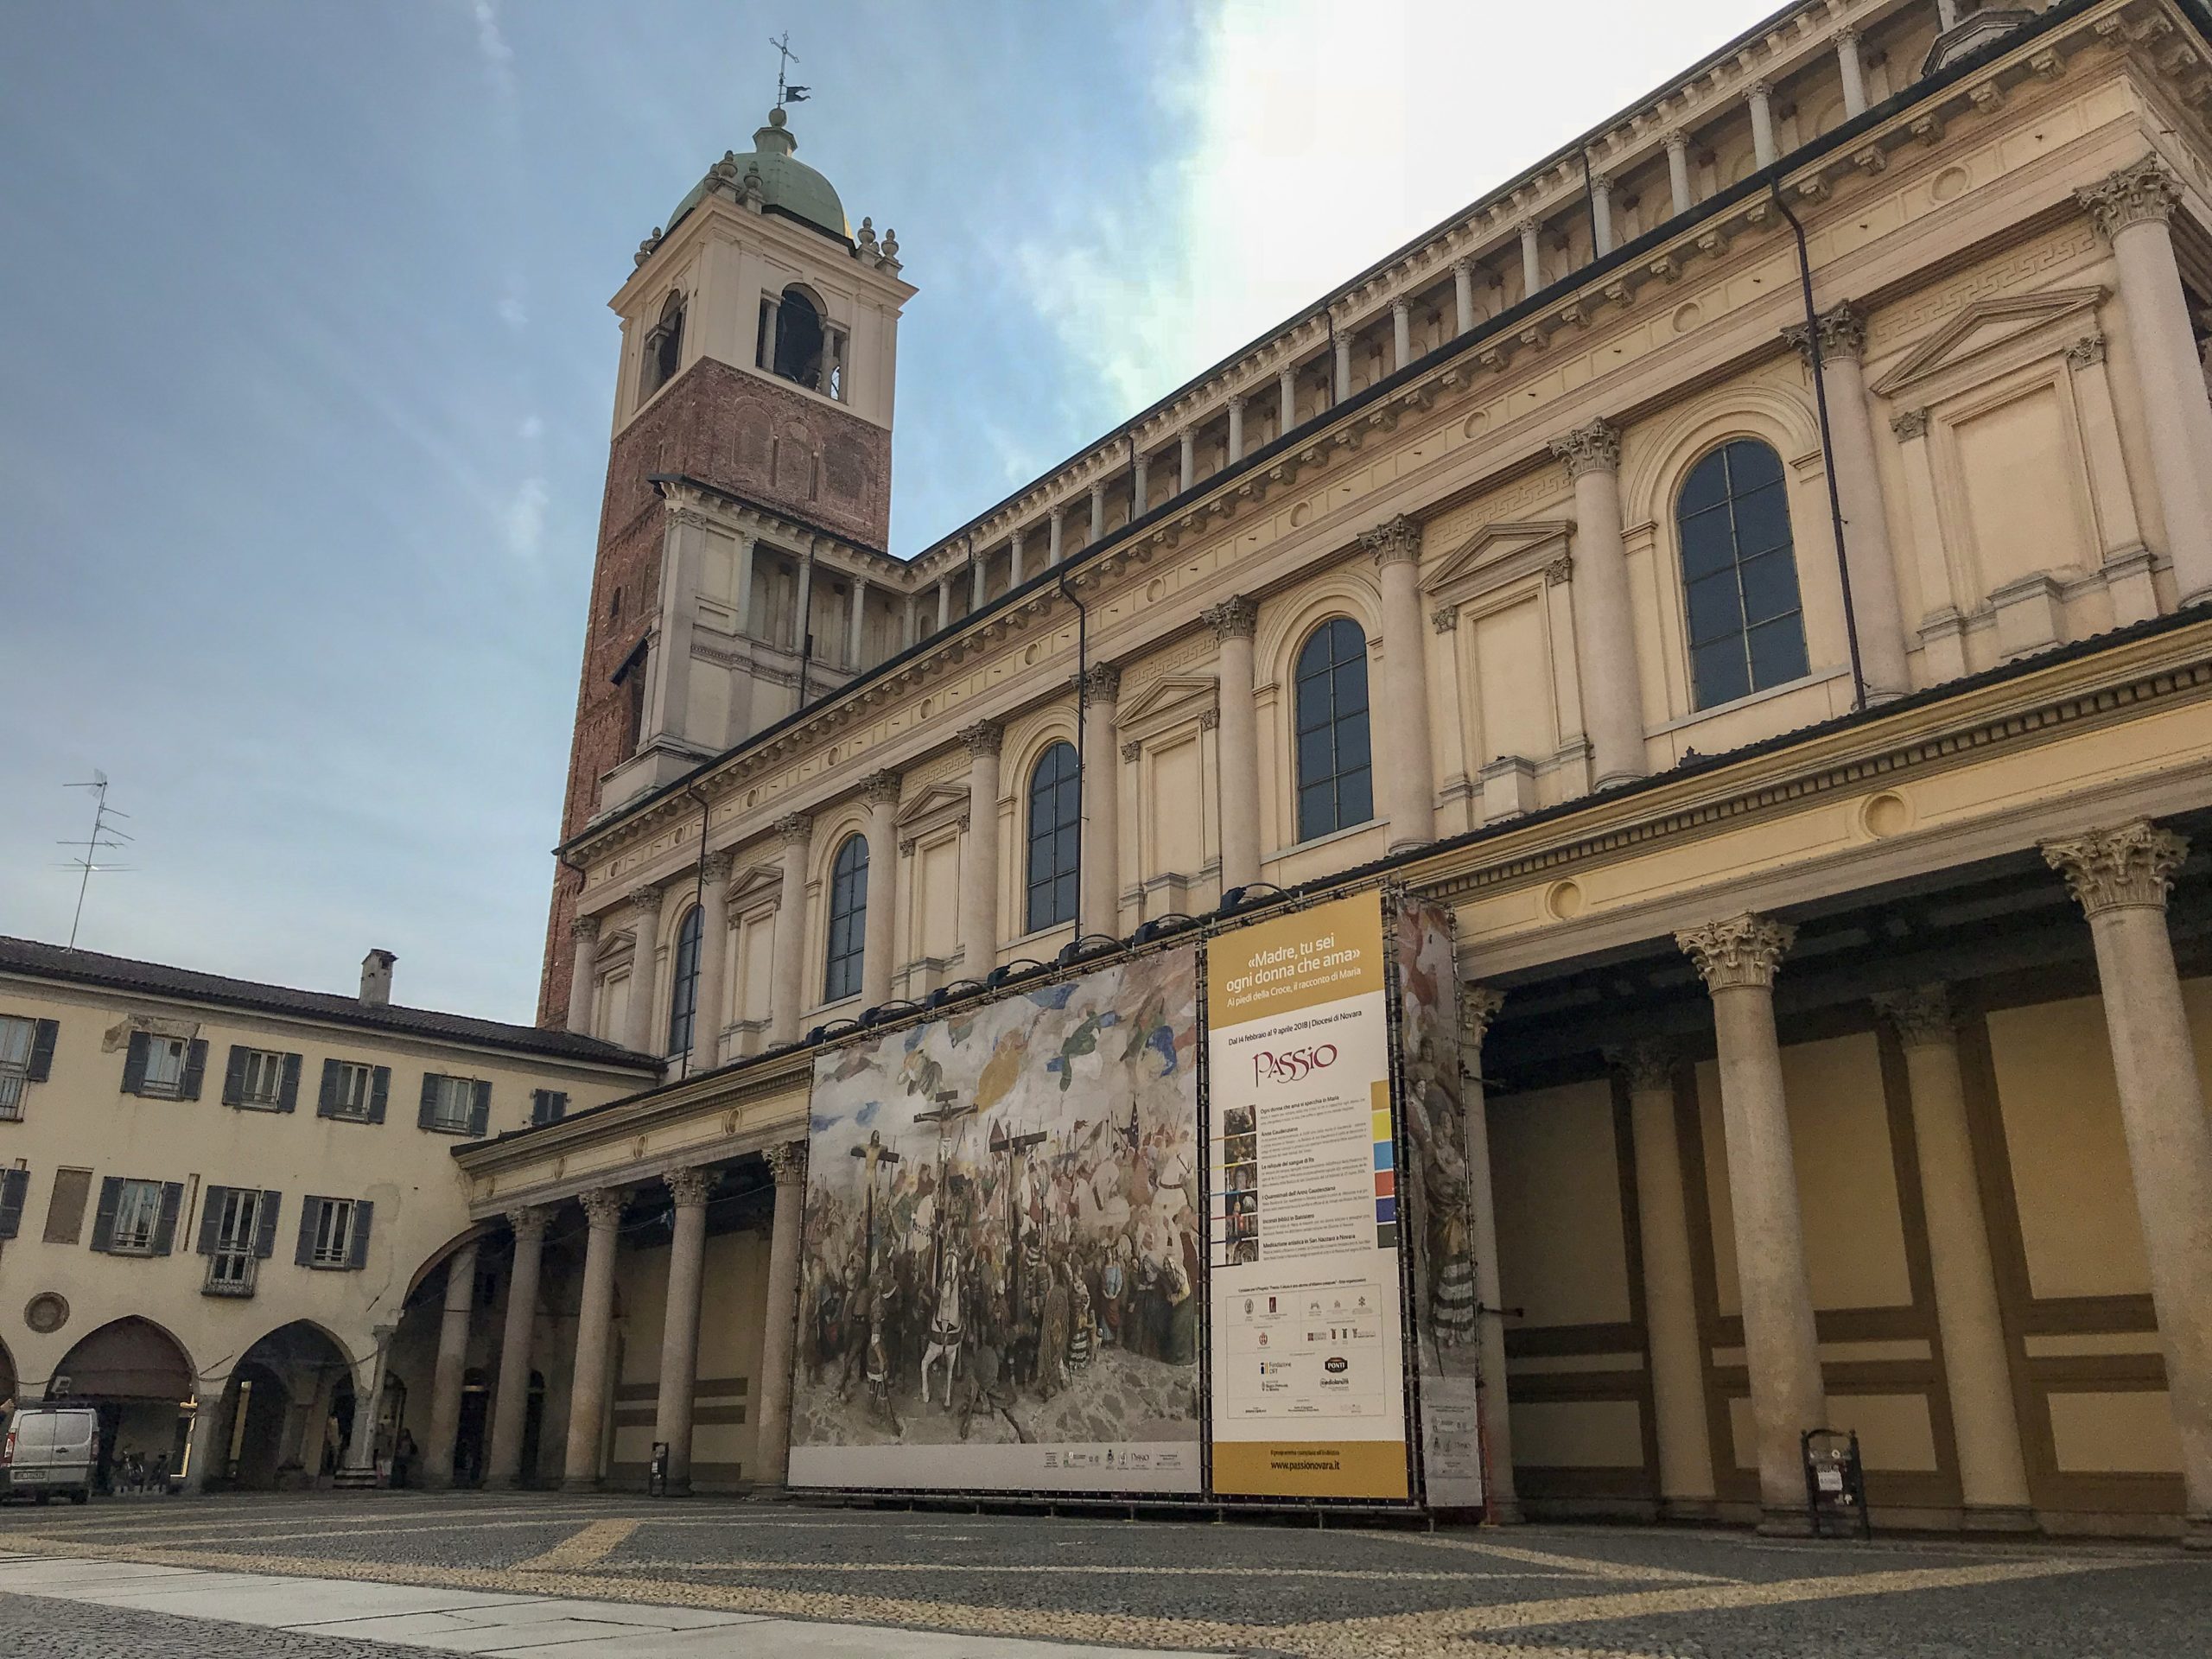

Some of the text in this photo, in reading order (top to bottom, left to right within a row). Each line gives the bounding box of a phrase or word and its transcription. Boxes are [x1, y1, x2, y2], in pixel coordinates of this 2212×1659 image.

[1248, 932, 1334, 968] «Madre, tu sei
[1226, 949, 1360, 993] ogni donna che ama»
[1236, 993, 1252, 1007] piedi
[1253, 989, 1269, 1001] della
[1270, 985, 1293, 995] Croce,
[1293, 982, 1298, 990] il
[1299, 976, 1330, 988] racconto
[1331, 971, 1338, 982] di
[1339, 967, 1361, 979] Maria
[1244, 1032, 1267, 1042] febbraio
[1278, 1026, 1293, 1035] aprile
[1294, 1021, 1308, 1031] 2018
[1312, 1016, 1332, 1027] Diocesi
[1339, 1010, 1362, 1020] Novara
[1270, 1460, 1340, 1471] www.passionovara.it
